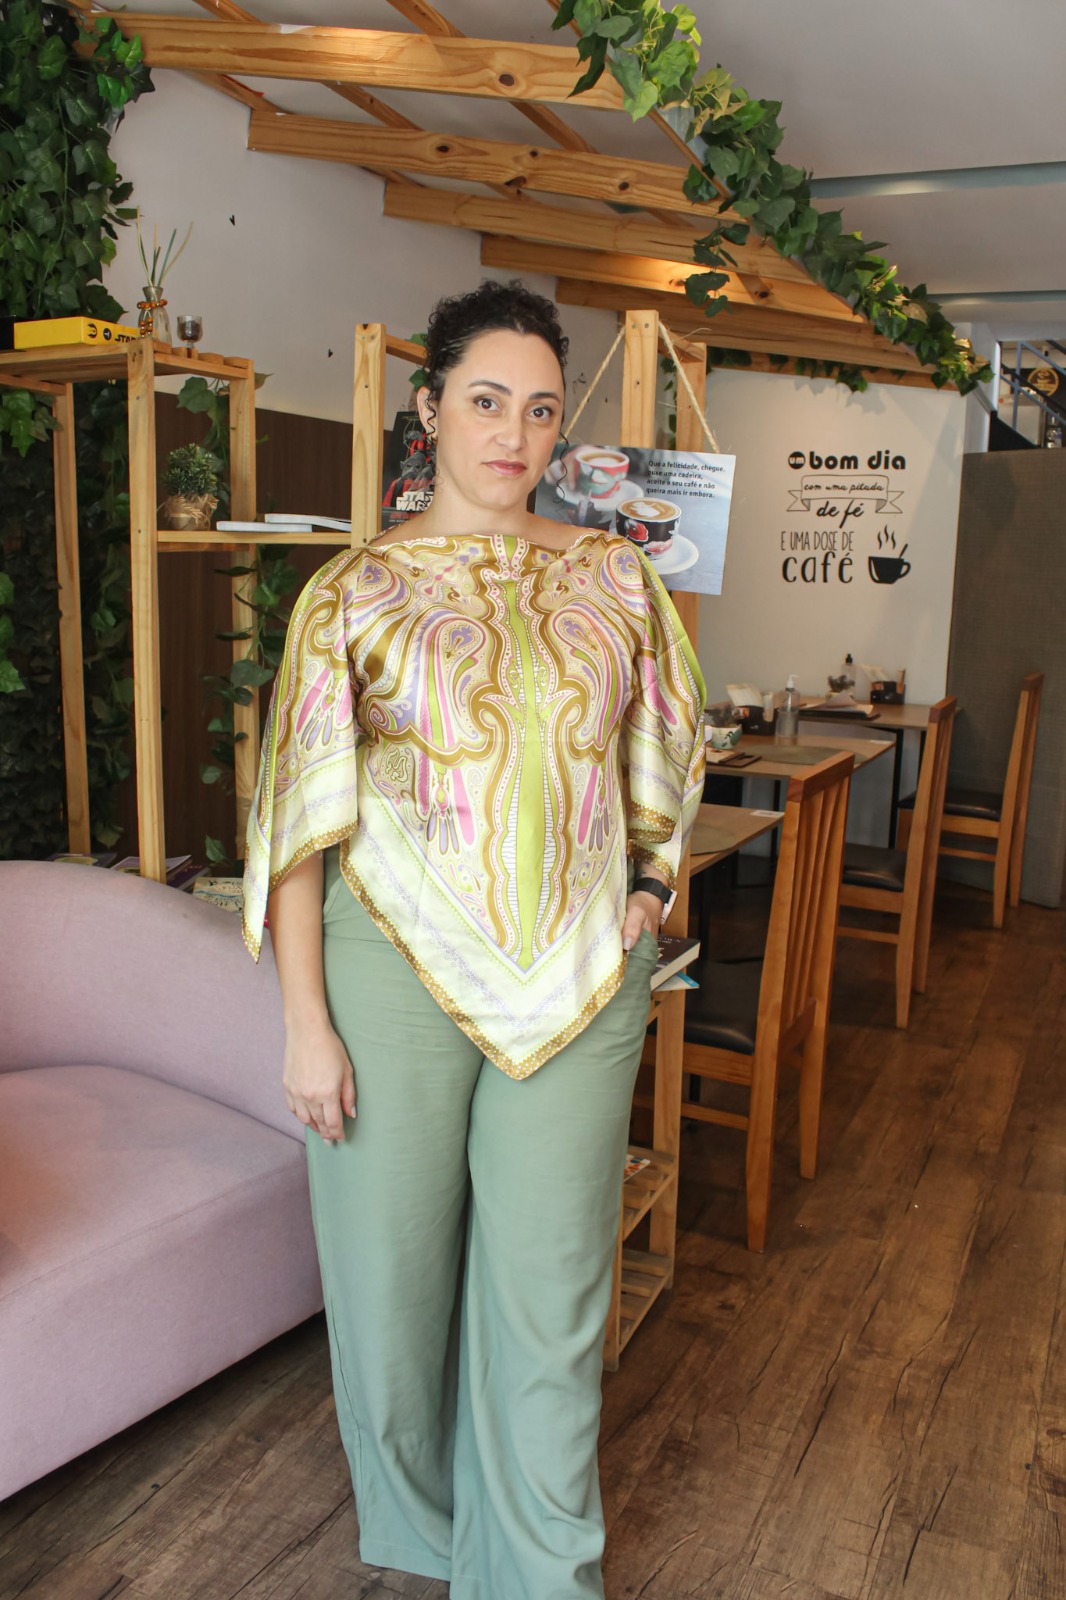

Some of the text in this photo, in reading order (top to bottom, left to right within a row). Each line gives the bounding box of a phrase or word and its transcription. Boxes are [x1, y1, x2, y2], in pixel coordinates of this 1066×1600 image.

[667, 461, 700, 471] felicidade,
[809, 451, 859, 470] bom
[867, 450, 906, 470] dia
[678, 472, 704, 480] cadeira,
[689, 490, 715, 498] embora.
[848, 482, 885, 494] pitada
[816, 499, 864, 529] de fé
[780, 531, 855, 551] E UMA DOSE DE
[782, 551, 853, 584] café
